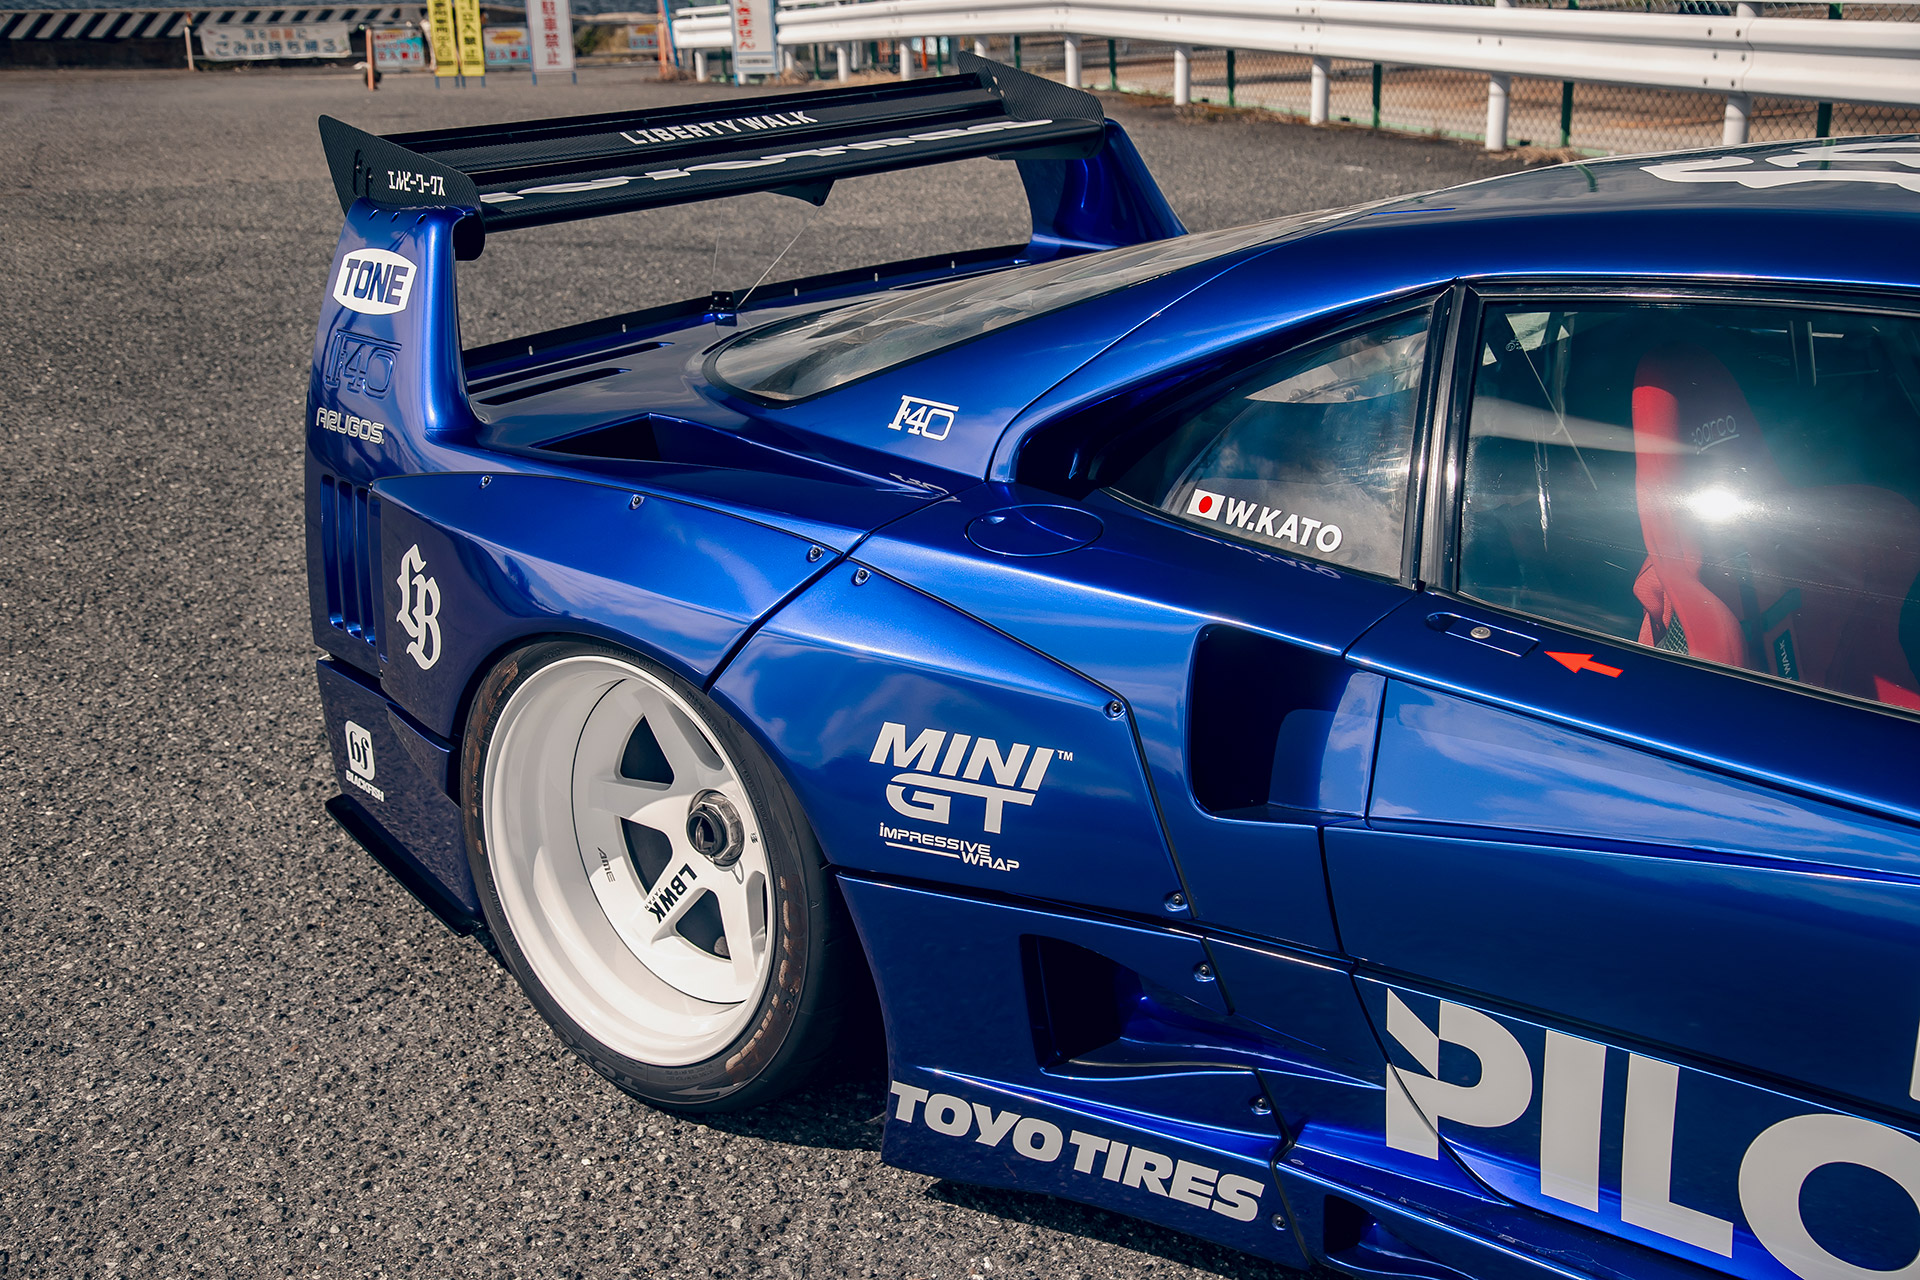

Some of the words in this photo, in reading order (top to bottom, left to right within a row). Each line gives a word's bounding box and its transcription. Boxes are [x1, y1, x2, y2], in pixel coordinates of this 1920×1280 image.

[620, 119, 742, 145] LIBERTY
[738, 110, 818, 130] WALK
[343, 258, 409, 306] TONE
[325, 328, 402, 401] F40
[888, 394, 960, 442] F40
[1225, 498, 1343, 554] W.KATO
[869, 721, 1055, 791] MINI
[886, 772, 1036, 834] GT
[961, 851, 1020, 872] WRAP
[647, 862, 698, 924] LBWK
[890, 1080, 1064, 1163] TOYO
[1069, 1129, 1266, 1223] TIRES
